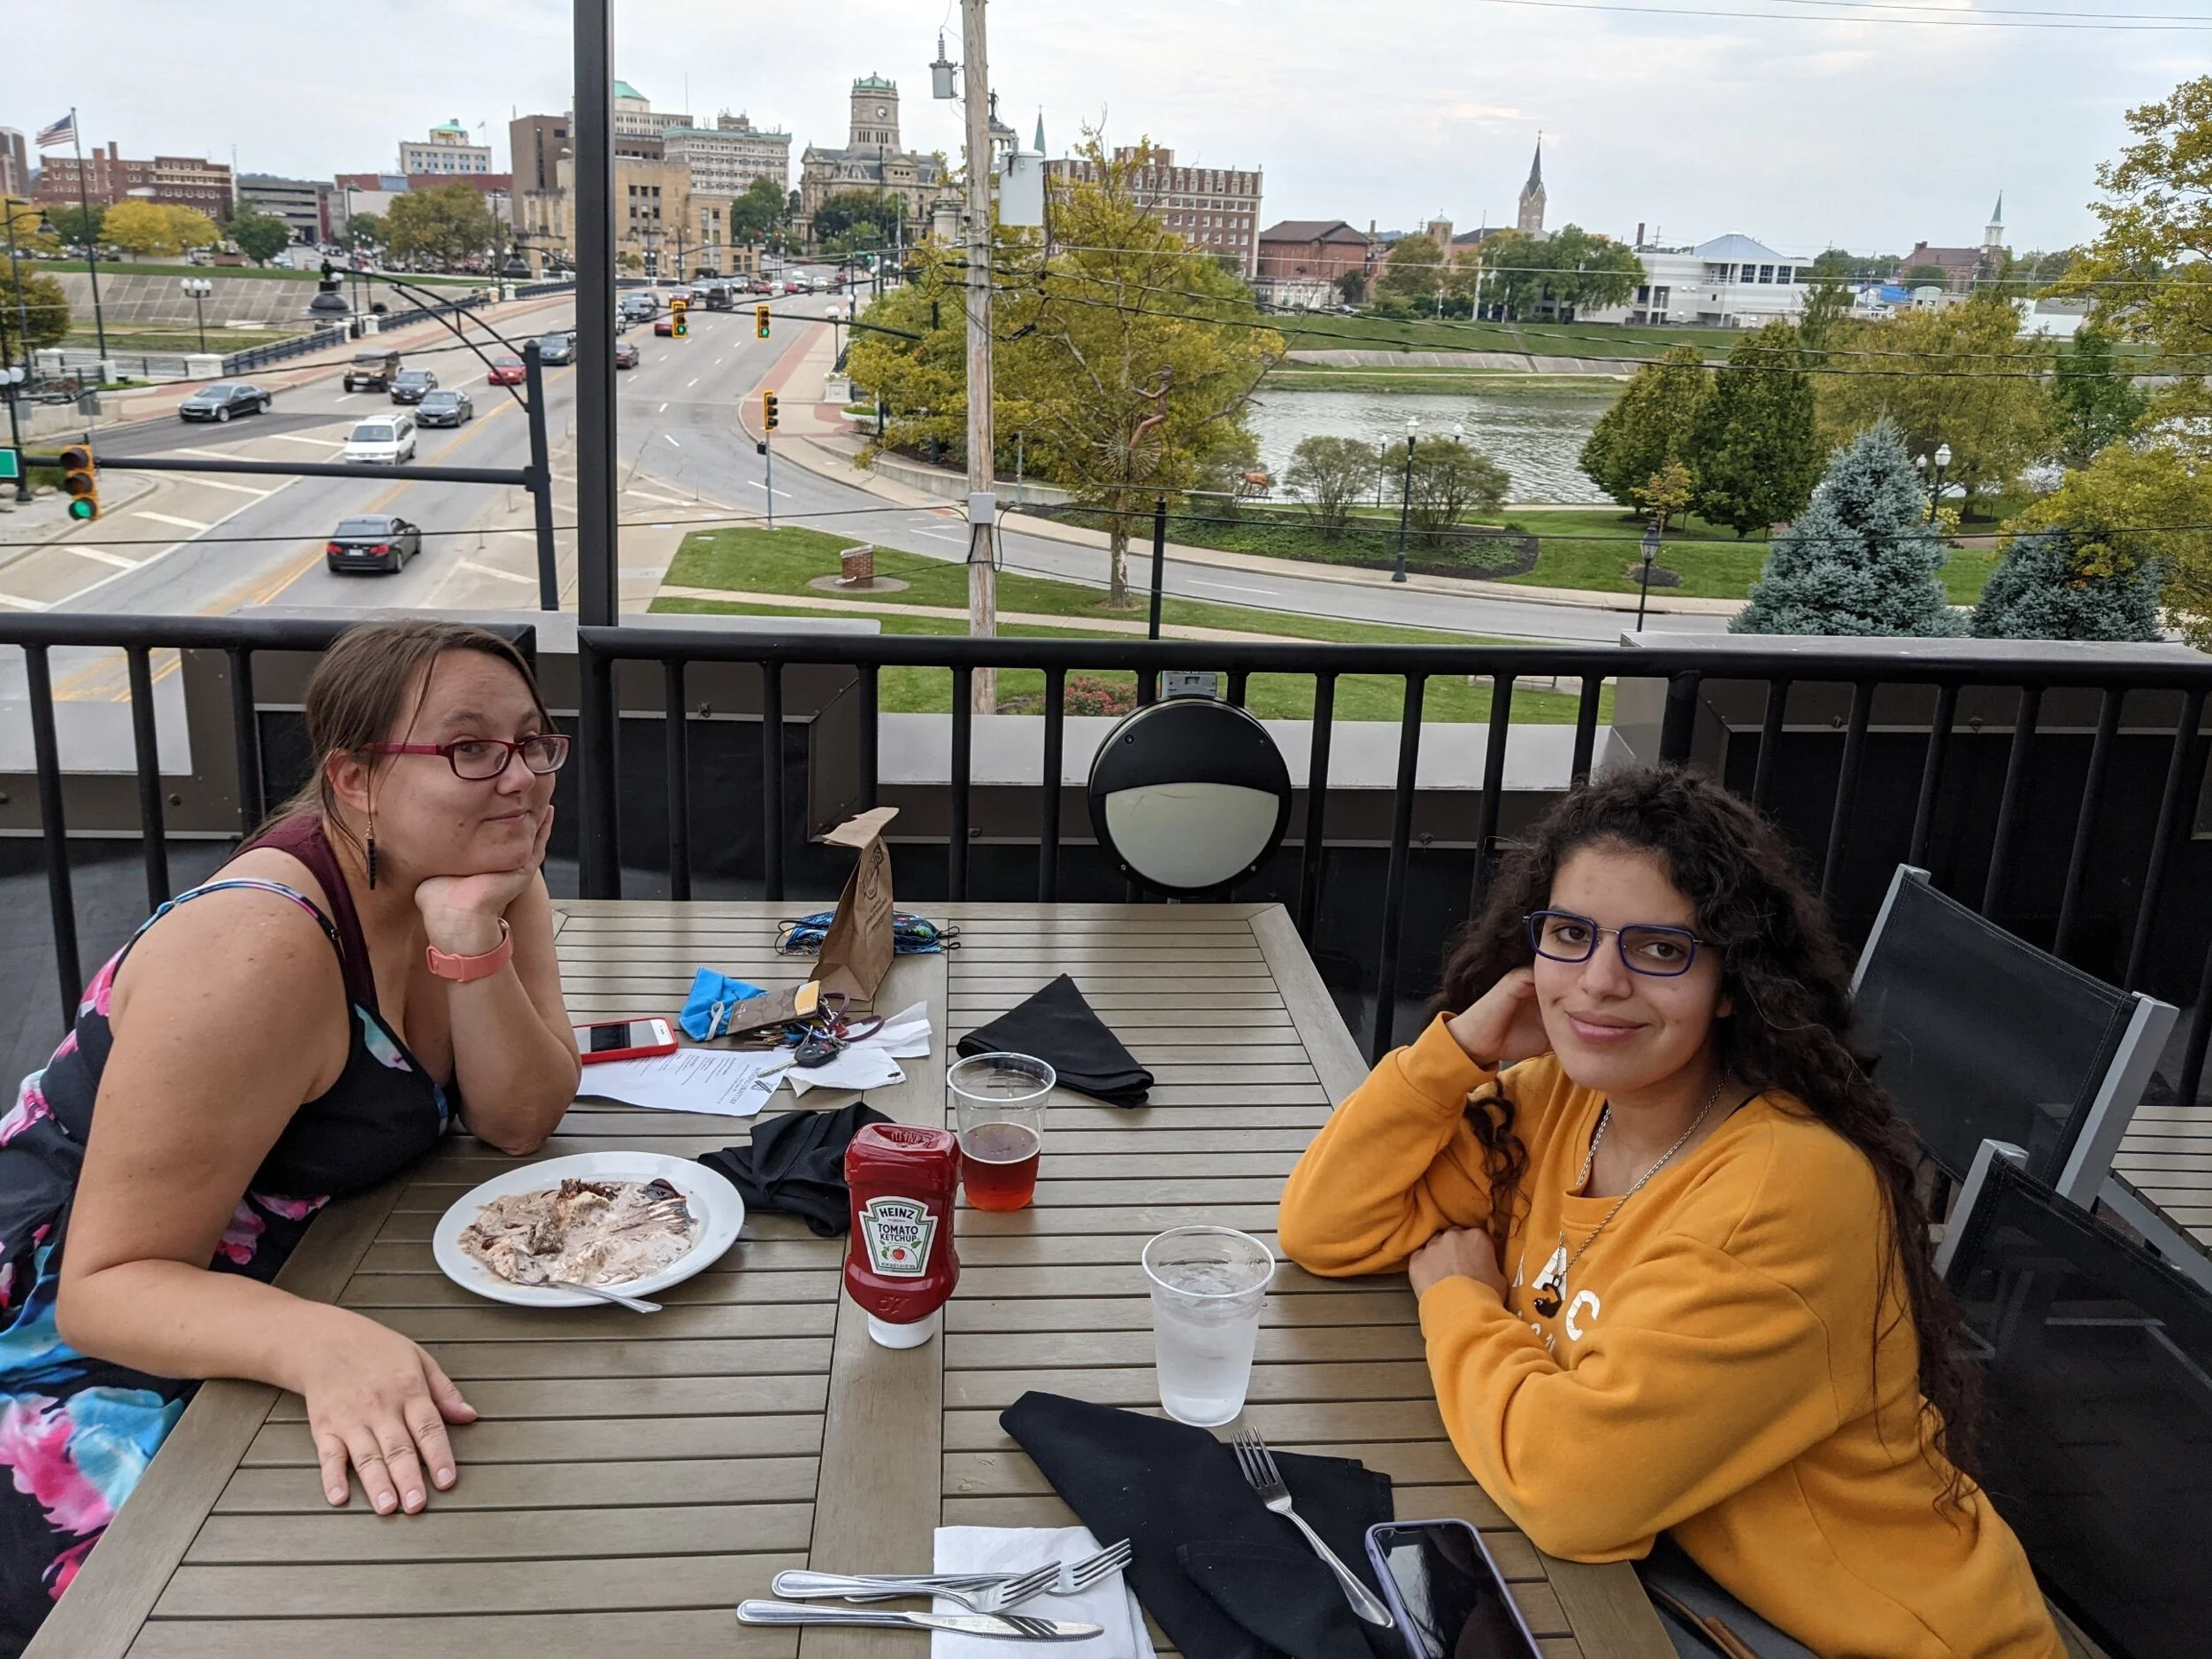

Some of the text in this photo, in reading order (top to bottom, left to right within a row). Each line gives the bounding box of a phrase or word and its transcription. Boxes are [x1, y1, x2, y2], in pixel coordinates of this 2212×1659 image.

[879, 1207, 916, 1220] HEINZ
[877, 1223, 918, 1235] TOMATO
[879, 1233, 918, 1242] KETCHUP
